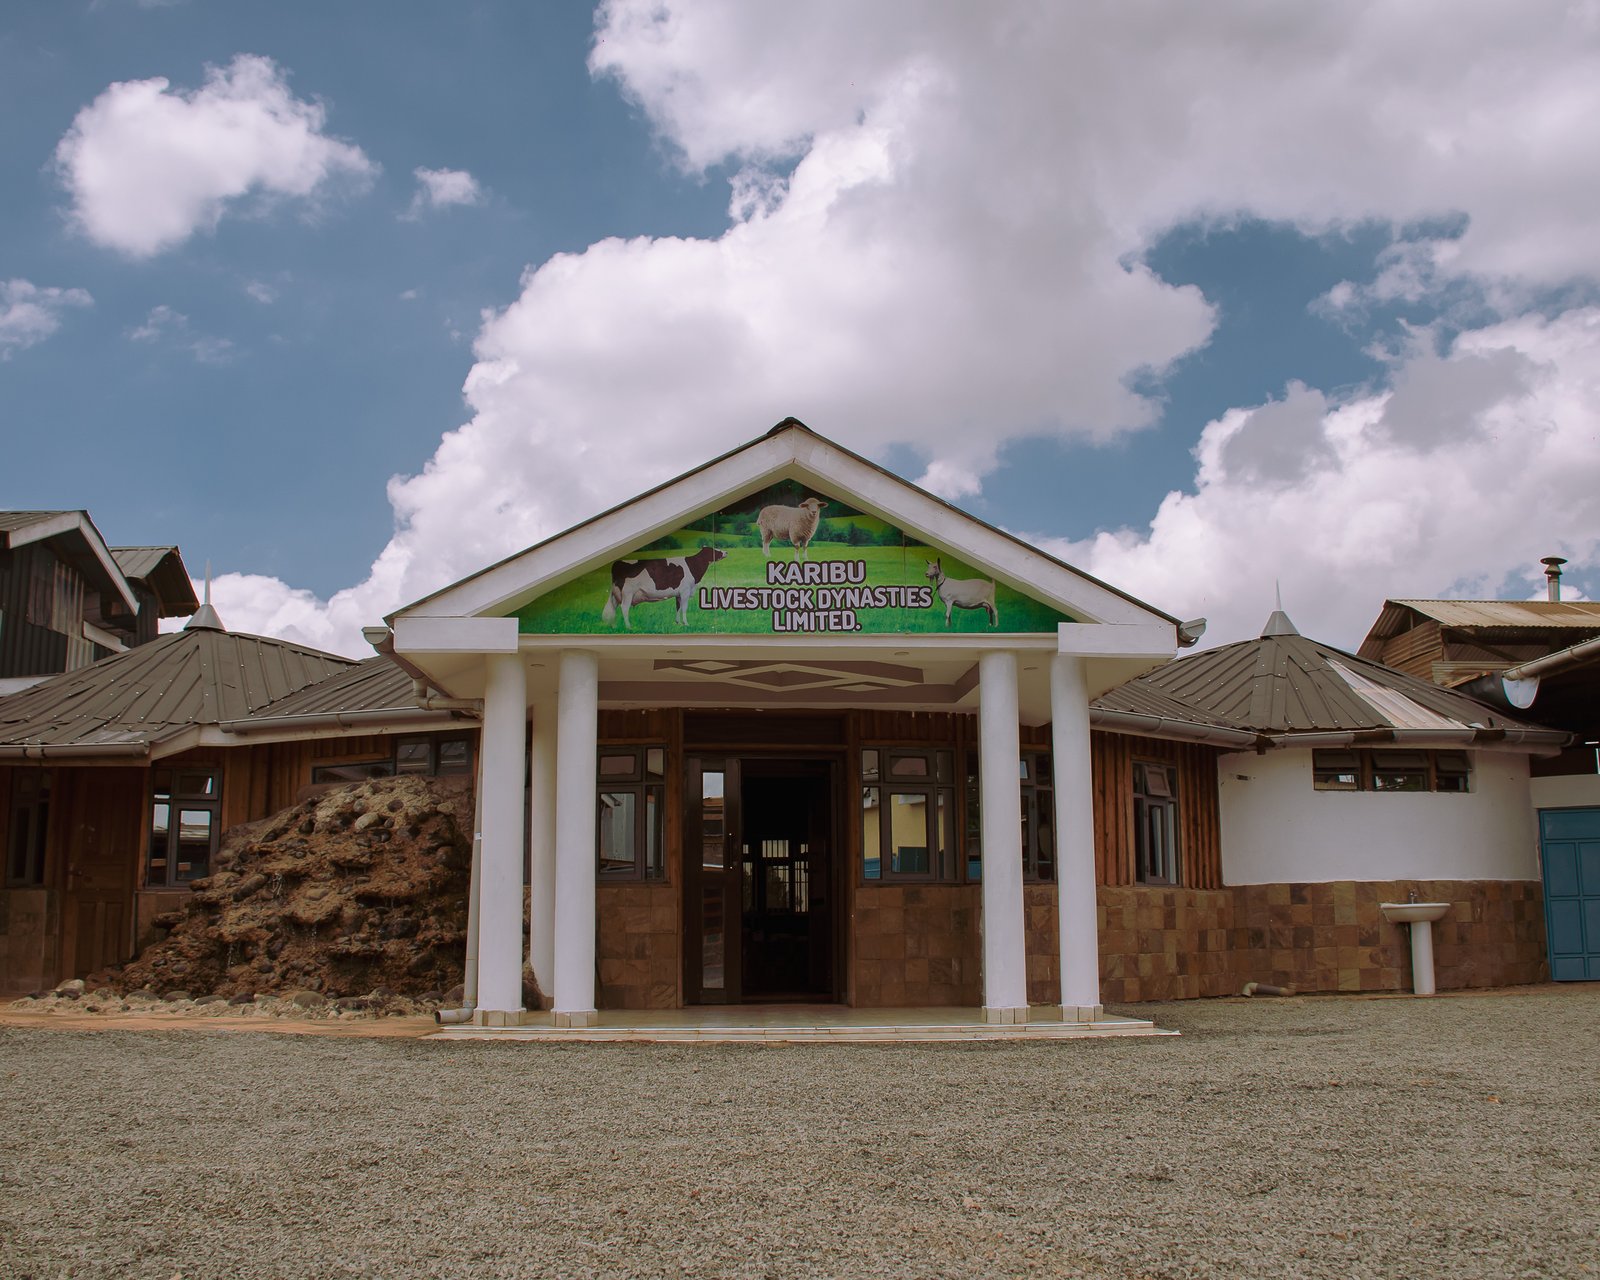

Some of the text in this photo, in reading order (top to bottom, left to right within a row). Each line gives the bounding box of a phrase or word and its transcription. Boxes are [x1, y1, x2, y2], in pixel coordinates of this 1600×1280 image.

[767, 561, 866, 584] KARIBU
[700, 587, 932, 609] LIVESTOCK DYNASTIES
[773, 610, 862, 631] LIMITED.
